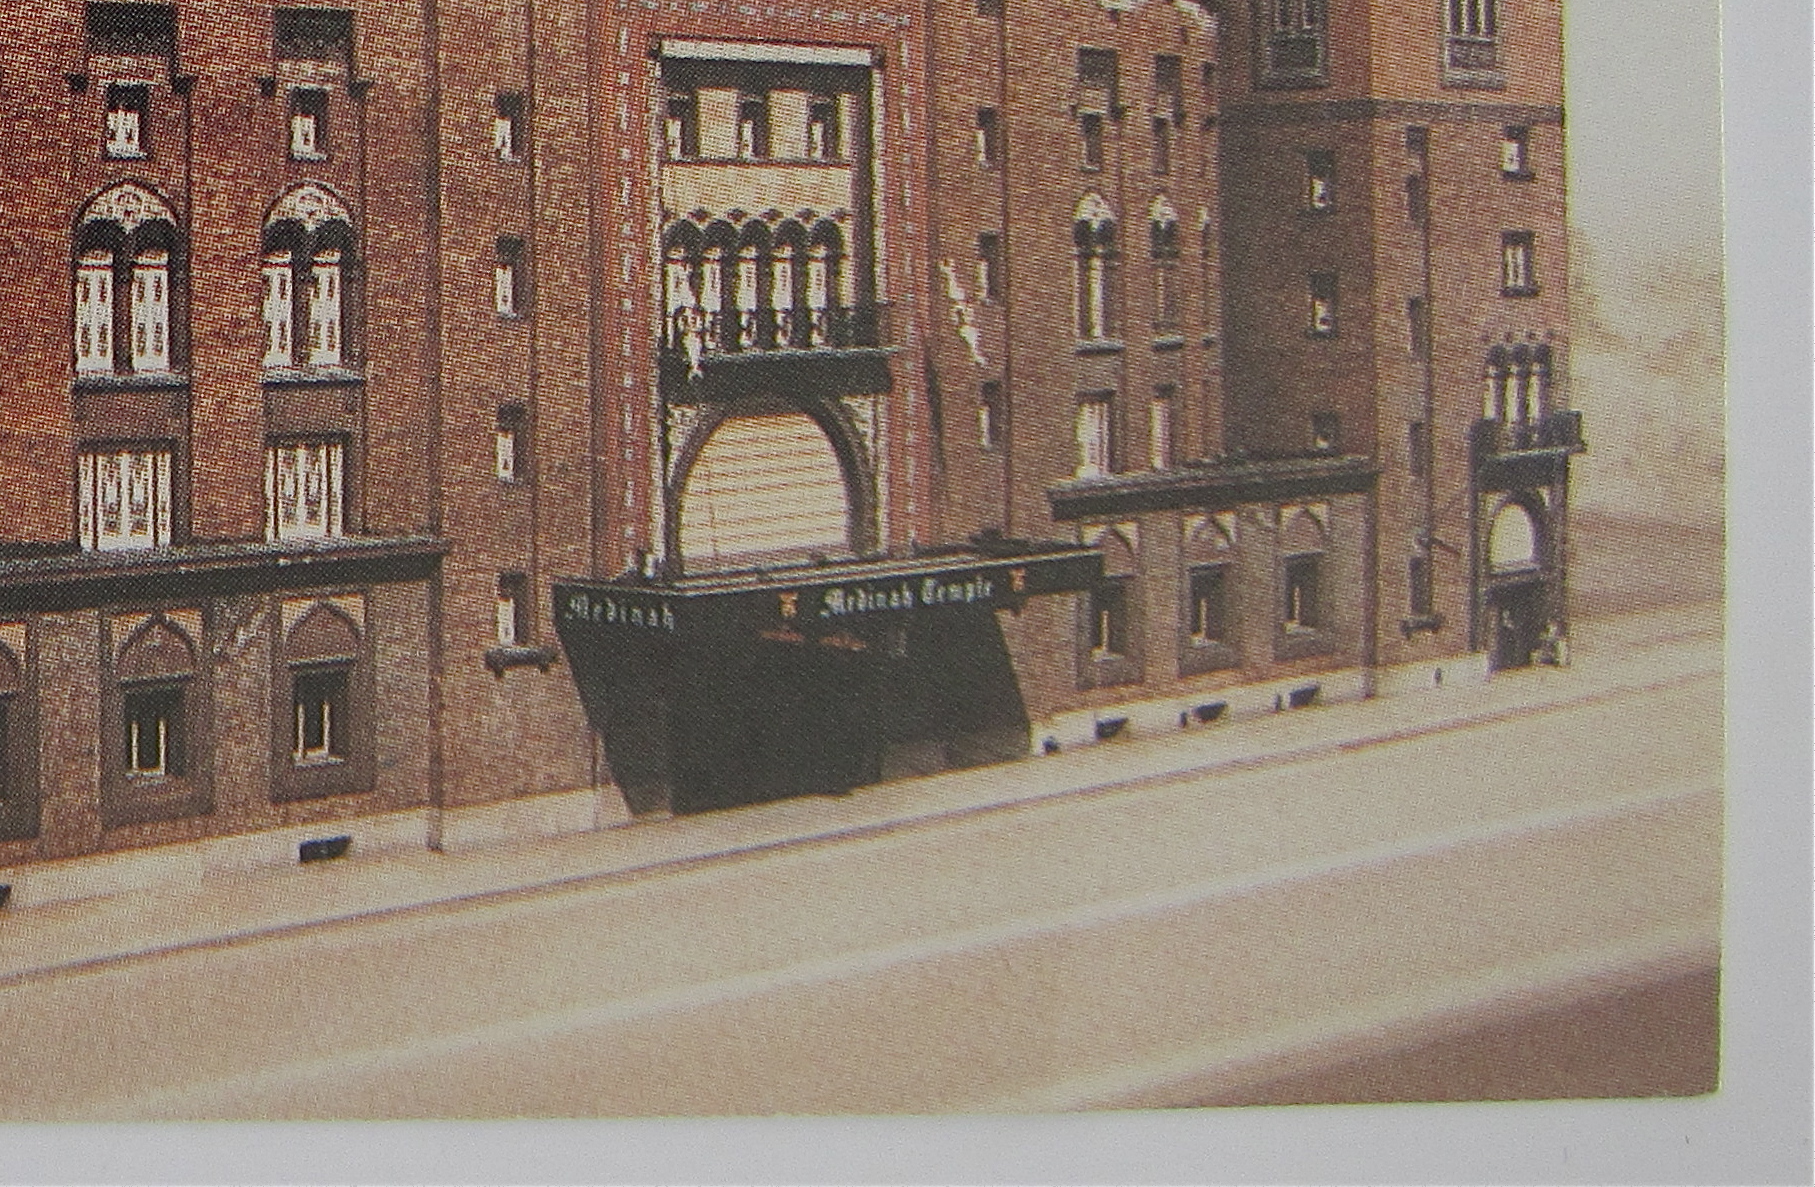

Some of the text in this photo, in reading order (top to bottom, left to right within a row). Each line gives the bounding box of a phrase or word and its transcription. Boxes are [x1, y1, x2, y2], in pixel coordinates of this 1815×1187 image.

[564, 592, 675, 633] Medinah
[819, 574, 992, 618] Medinah Temple
